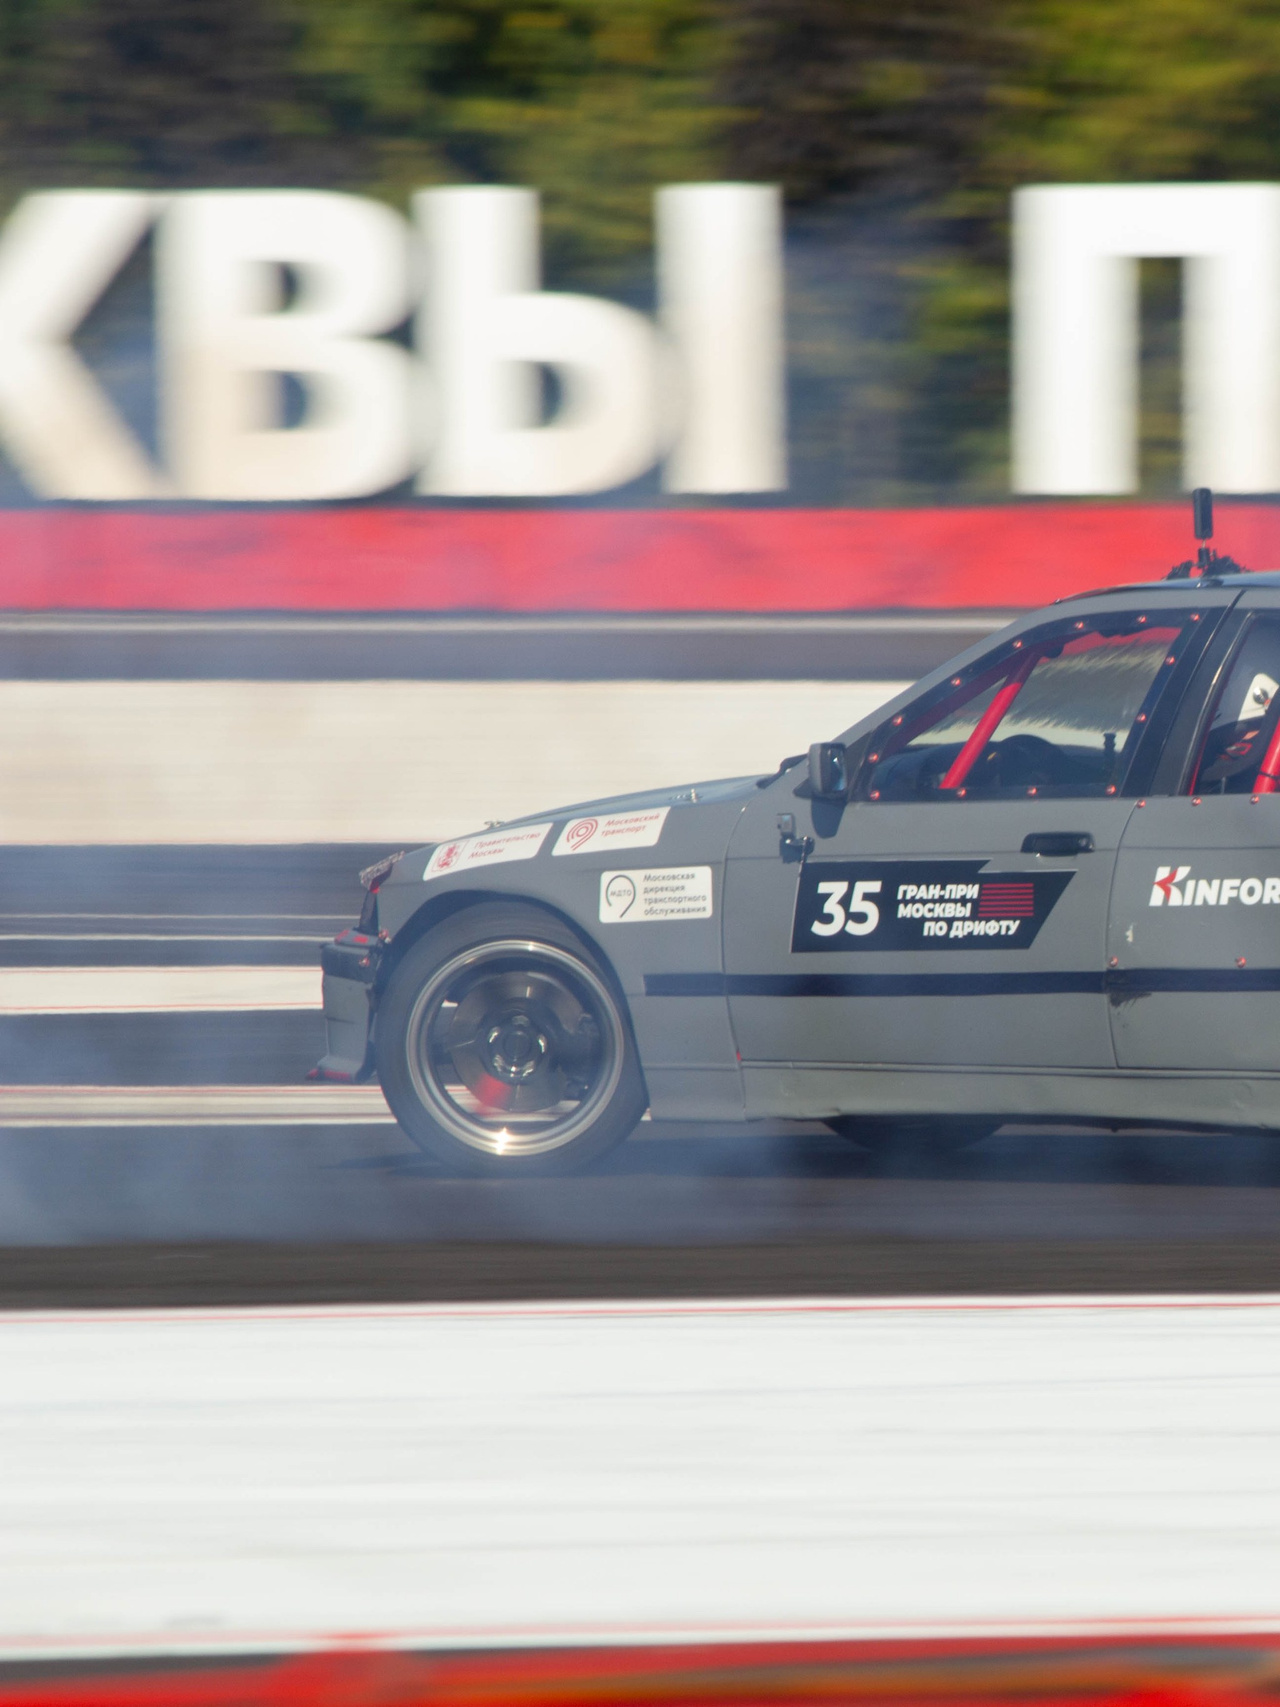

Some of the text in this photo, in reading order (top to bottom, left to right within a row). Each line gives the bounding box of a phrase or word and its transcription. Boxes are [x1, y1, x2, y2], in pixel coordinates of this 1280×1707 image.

[604, 813, 660, 827] Московский
[601, 825, 647, 837] транспорт
[474, 832, 542, 849] Правительство
[467, 848, 505, 860] Москвы
[643, 873, 695, 882] Московская
[643, 885, 685, 895] дирекция
[897, 884, 980, 900] ГРАН-ПРИ
[644, 895, 707, 906] транспортного
[644, 906, 707, 917] обслуживания
[810, 880, 882, 936] 35
[897, 902, 972, 919] МОСКВЫ
[923, 919, 1021, 939] ПО ДРИФТУ
